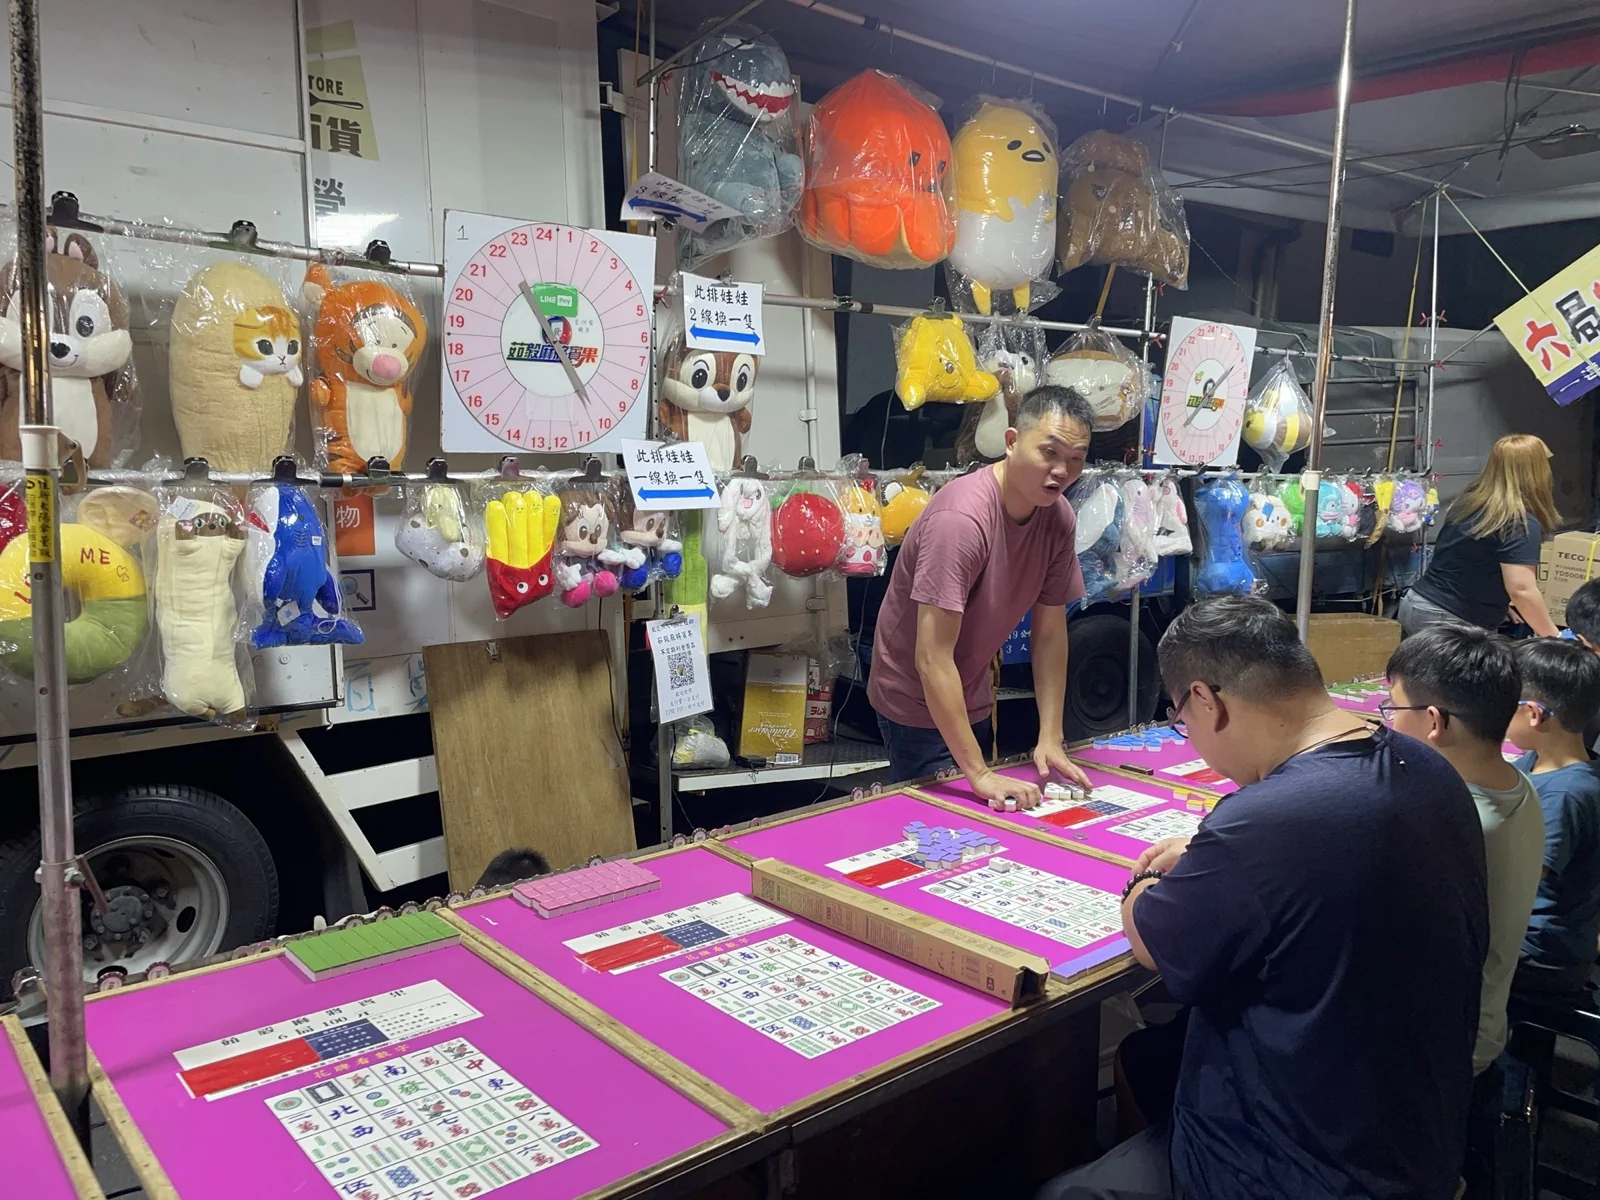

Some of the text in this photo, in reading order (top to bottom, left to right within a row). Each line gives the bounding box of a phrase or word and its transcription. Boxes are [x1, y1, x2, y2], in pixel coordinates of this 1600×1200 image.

[511, 233, 528, 245] 23
[536, 228, 552, 240] 24
[568, 231, 573, 242] 1
[489, 245, 507, 257] 22
[590, 241, 598, 253] 2
[610, 258, 618, 270] 3
[470, 264, 487, 277] 21
[625, 280, 633, 291] 4
[455, 289, 473, 301] 20
[540, 296, 571, 305] LINE Pay
[694, 284, 749, 306] 此排娃娃
[636, 305, 644, 316] 5
[449, 316, 465, 328] 19
[641, 332, 648, 343] 6
[448, 343, 464, 355] 18
[639, 356, 646, 367] 7
[454, 370, 470, 382] 17
[1243, 372, 1246, 380] 5
[631, 380, 639, 391] 8
[467, 396, 483, 407] 16
[619, 401, 626, 412] 9
[485, 414, 500, 425] 15
[1164, 412, 1170, 420] 17
[599, 418, 611, 429] 10
[506, 429, 521, 441] 14
[578, 431, 591, 442] 11
[531, 437, 545, 448] 13
[554, 437, 568, 448] 12
[636, 449, 695, 464] 此排娃娃
[634, 470, 709, 485] 一線換一隻
[336, 506, 360, 528] 物
[80, 548, 110, 565] ME
[1558, 551, 1585, 562] TECO
[1006, 643, 1028, 654] 3 人
[748, 722, 799, 738] Budweiser
[718, 978, 739, 988] 北
[322, 1016, 348, 1027] 100
[384, 1065, 407, 1078] 南
[464, 1059, 484, 1072] 中
[399, 1080, 428, 1095] 發
[488, 1078, 514, 1091] 東
[329, 1105, 358, 1120] 北
[349, 1125, 373, 1138] 西
